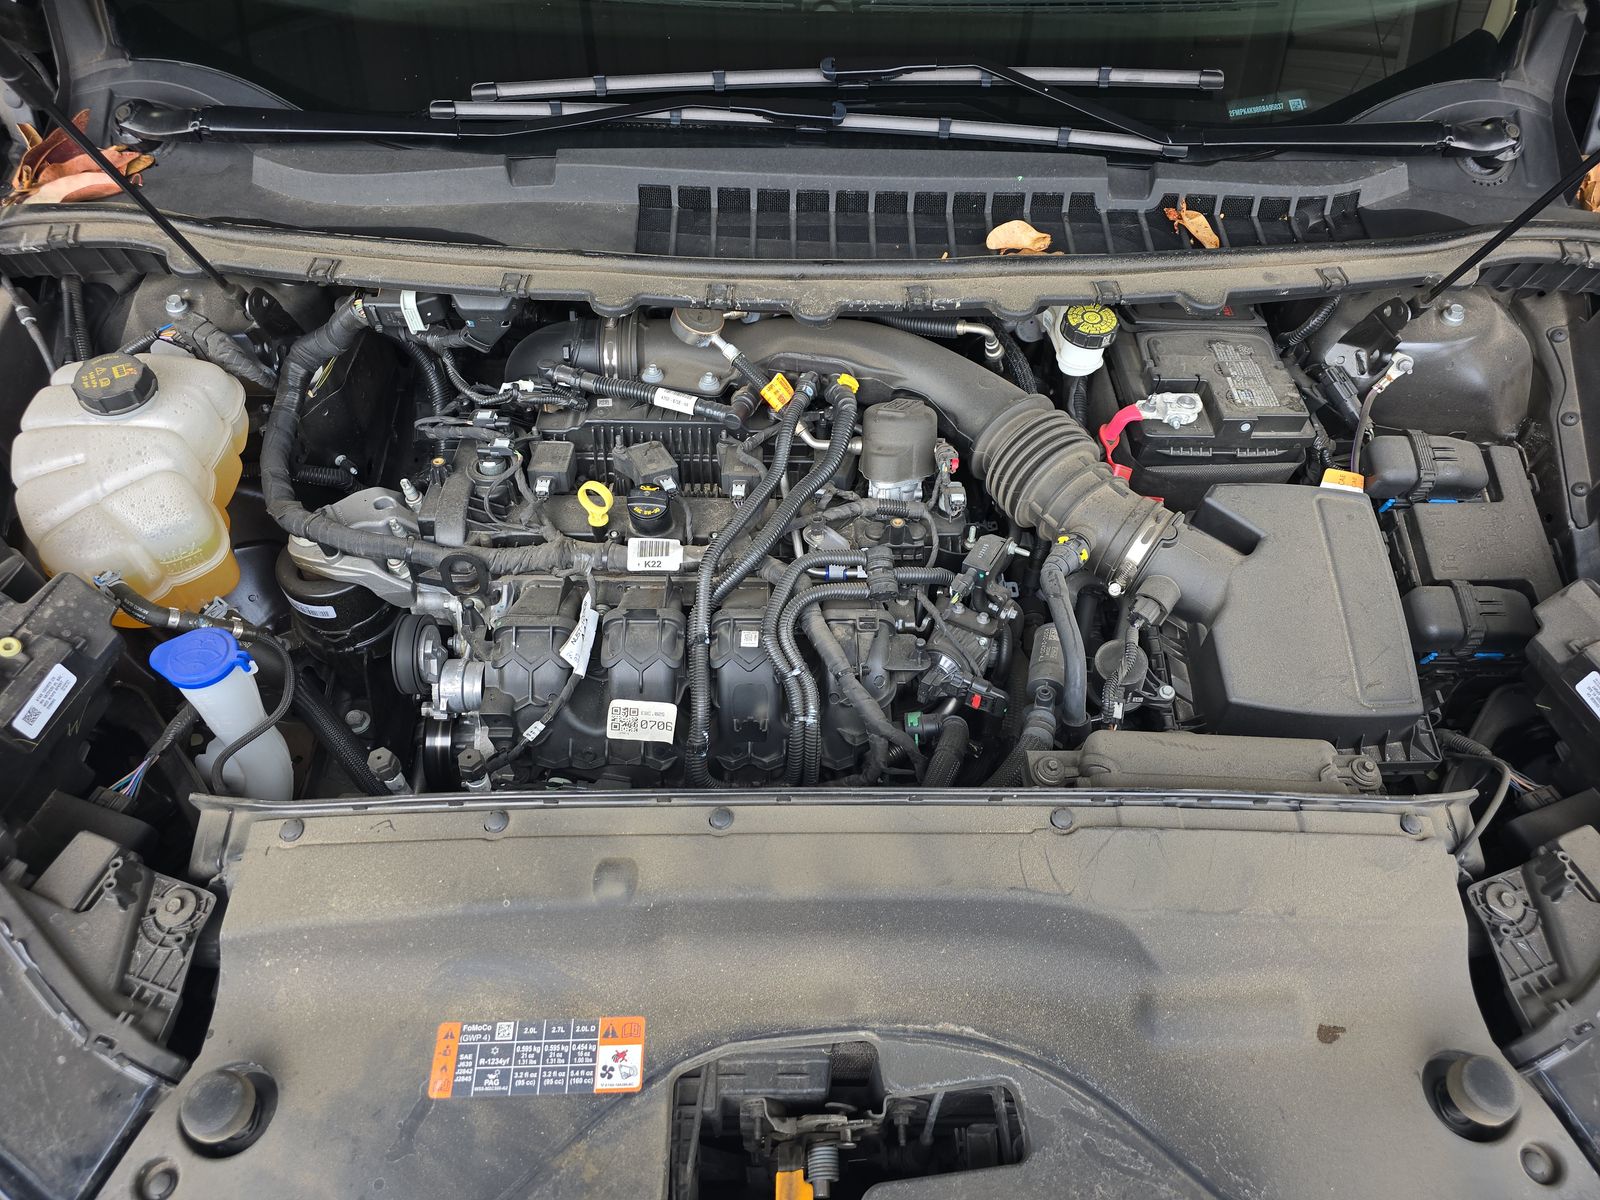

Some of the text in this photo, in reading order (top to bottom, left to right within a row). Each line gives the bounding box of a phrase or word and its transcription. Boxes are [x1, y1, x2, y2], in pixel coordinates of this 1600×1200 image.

[644, 560, 662, 568] K22
[640, 719, 673, 732] 0706
[463, 1024, 492, 1032] FoMoCo
[460, 1034, 491, 1043] (GWP 4)
[533, 1045, 541, 1054] kg
[561, 1044, 569, 1053] kg
[589, 1043, 597, 1052] kg
[479, 1057, 510, 1066] R-1234yf
